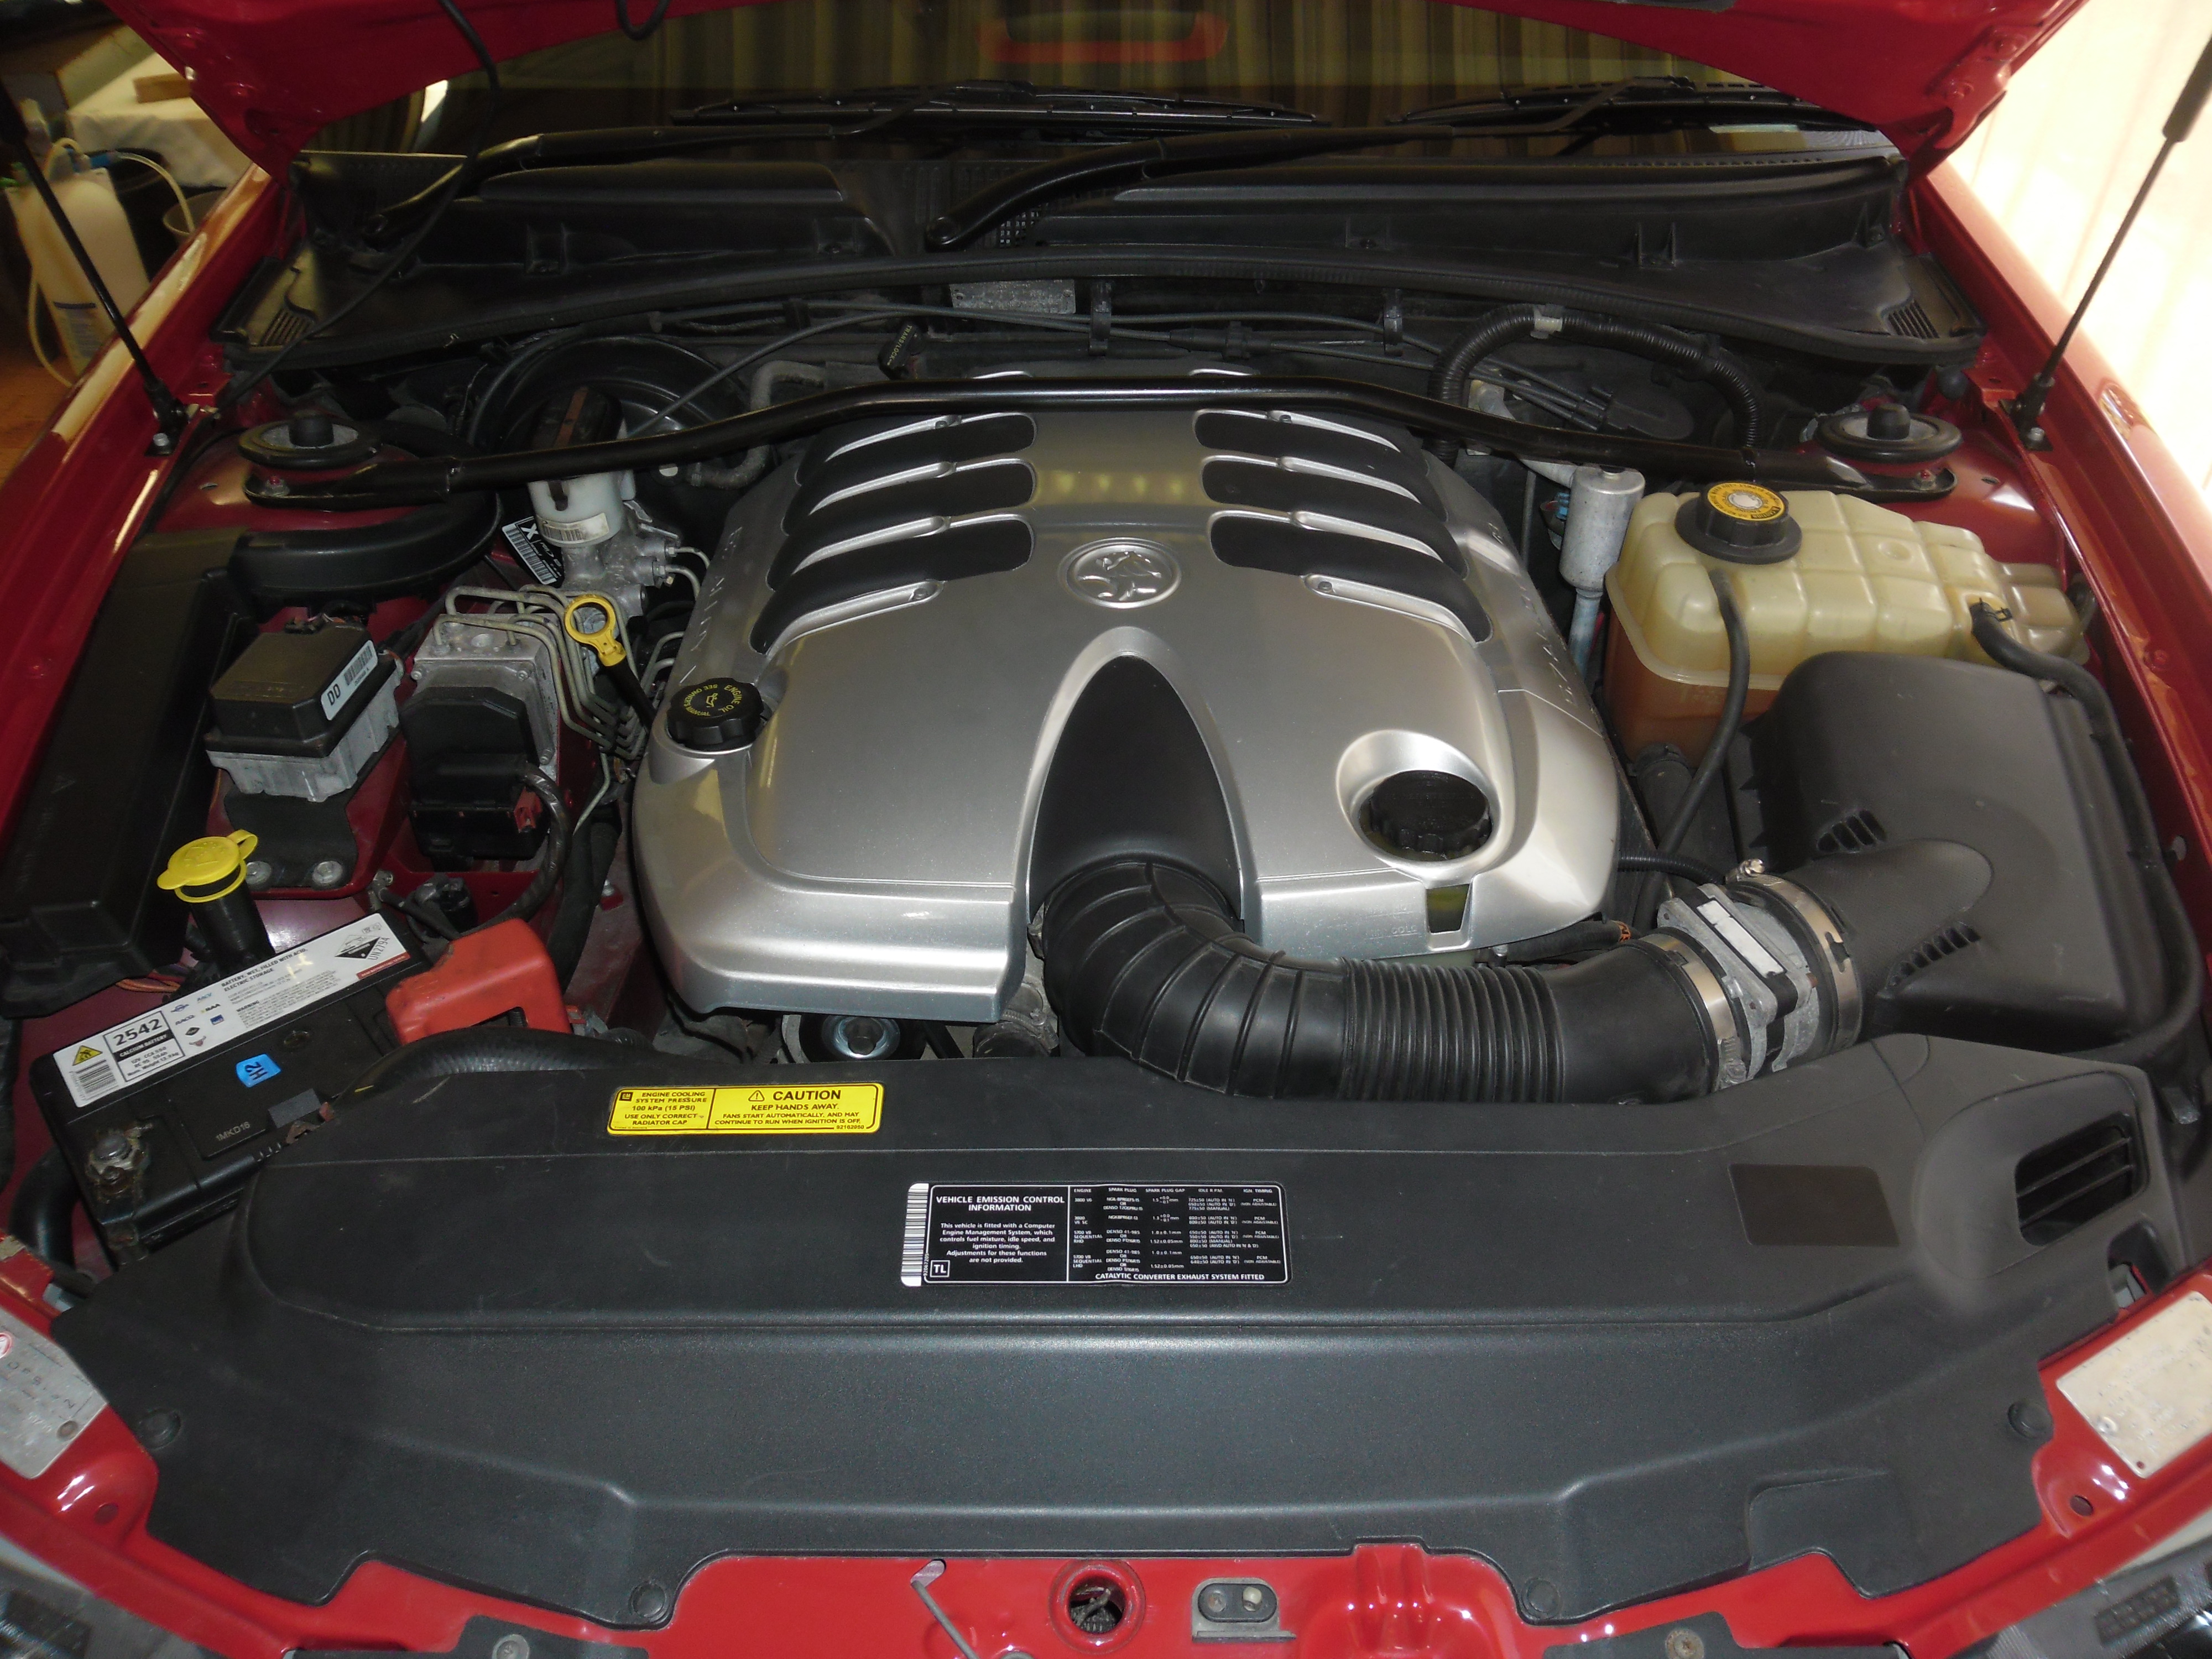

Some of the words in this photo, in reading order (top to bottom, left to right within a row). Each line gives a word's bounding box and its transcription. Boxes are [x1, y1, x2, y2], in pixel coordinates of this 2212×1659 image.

[520, 523, 539, 540] X
[327, 684, 341, 706] DD
[724, 685, 742, 705] ENGINE
[686, 706, 711, 716] MANUAL
[718, 705, 734, 713] OIL
[368, 937, 390, 960] UN2794
[223, 978, 249, 992] ELECTRIC
[249, 968, 274, 981] STORAGE
[236, 1000, 260, 1013] WARNING
[113, 1019, 163, 1046] 2542
[119, 1044, 144, 1057] CALCIUM
[144, 1034, 167, 1047] BATTERY
[244, 1061, 268, 1081] H2
[773, 1090, 841, 1100] CAUTION
[934, 1264, 947, 1274] TL
